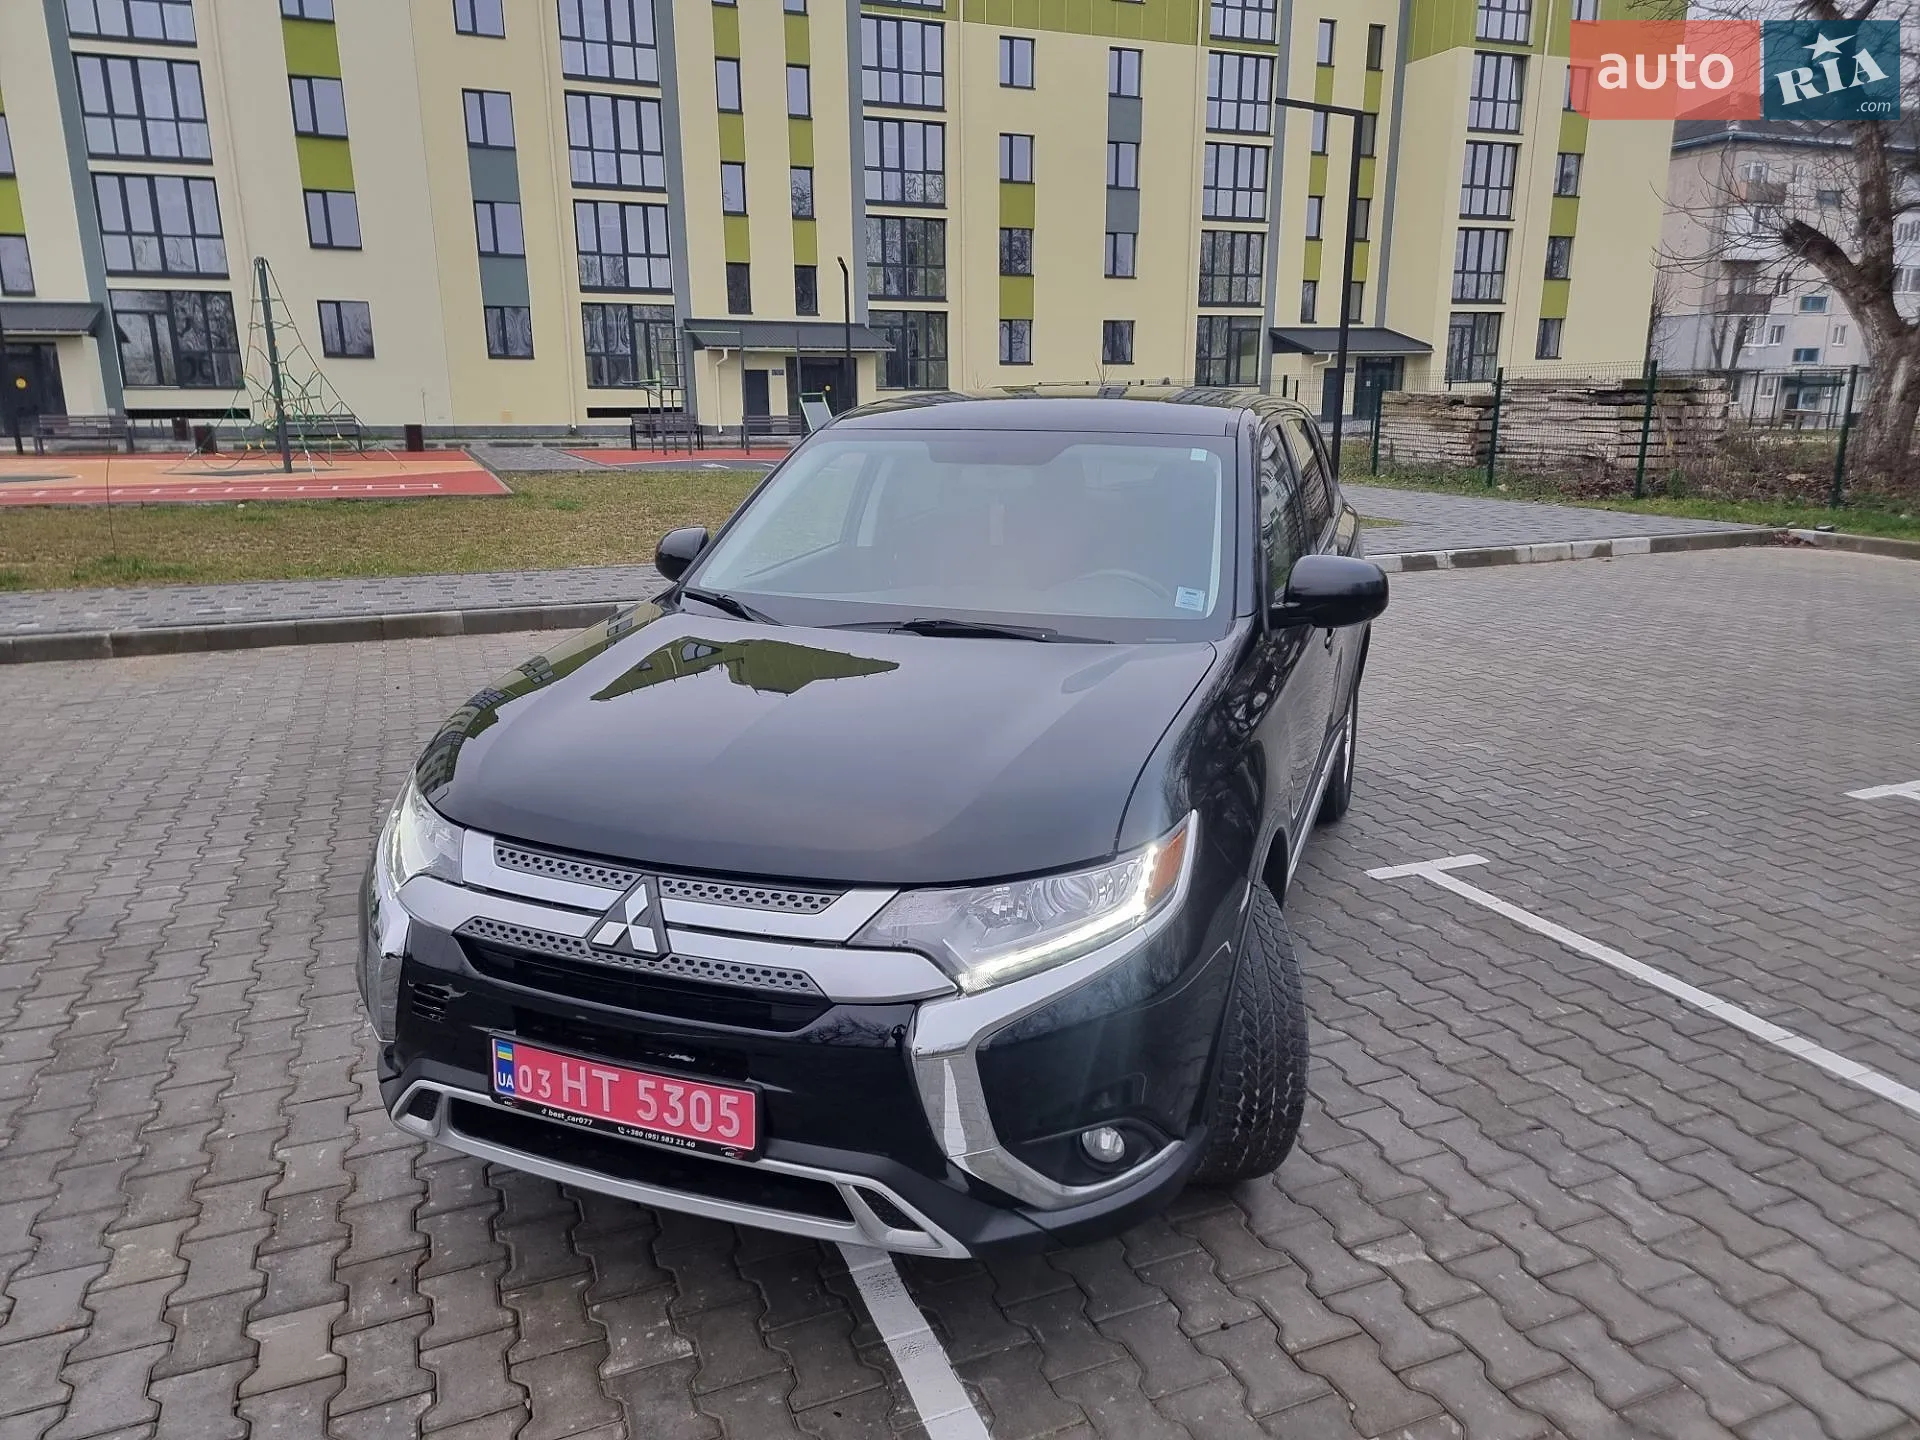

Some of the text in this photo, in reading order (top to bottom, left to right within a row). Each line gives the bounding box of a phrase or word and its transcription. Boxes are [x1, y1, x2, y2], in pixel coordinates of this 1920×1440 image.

[498, 1072, 515, 1089] UA
[519, 1062, 740, 1138] 03 HT 5305
[548, 1109, 593, 1125] best_car077
[626, 1129, 643, 1138] +380
